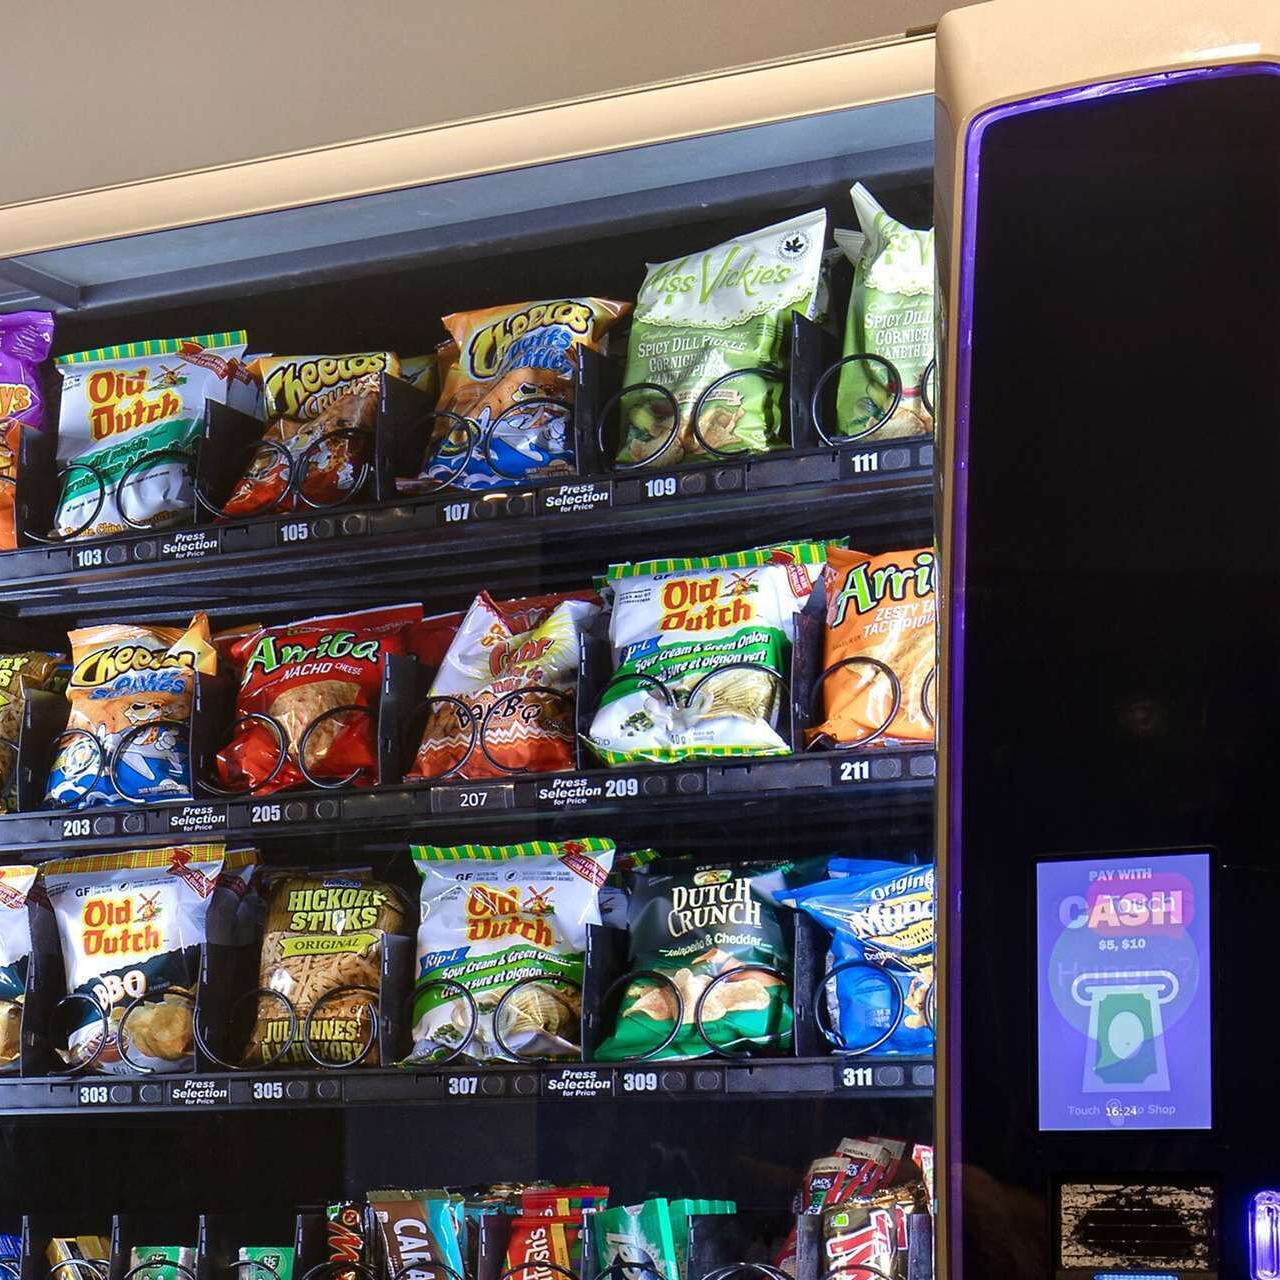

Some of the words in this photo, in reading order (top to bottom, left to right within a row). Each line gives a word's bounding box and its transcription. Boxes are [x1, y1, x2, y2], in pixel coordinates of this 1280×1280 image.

[471, 301, 592, 380] Cheetos
[638, 341, 670, 358] SPICY
[673, 337, 700, 354] DILL
[88, 368, 150, 404] Old
[265, 352, 388, 417] Cheetos
[90, 391, 182, 443] Dutch
[852, 453, 878, 472] 111
[559, 483, 594, 495] Press
[645, 478, 676, 497] 109
[546, 492, 608, 507] Selection
[573, 503, 594, 512] Price
[443, 504, 470, 522] 107
[175, 532, 205, 542] Press
[280, 523, 308, 541] 105
[162, 539, 218, 555] Selection
[76, 549, 102, 566] 103
[663, 577, 721, 610] Old
[659, 598, 753, 632] Dutch
[283, 662, 333, 682] NACHO
[335, 662, 363, 676] CHEESE
[840, 762, 869, 781] 211
[553, 777, 588, 789] Press
[605, 779, 639, 798] 209
[460, 793, 487, 808] 207
[539, 786, 602, 800] Selection
[170, 813, 226, 827] Selection
[183, 806, 213, 817] Press
[252, 805, 281, 822] 205
[63, 820, 91, 837] 203
[1089, 870, 1115, 882] PAY
[1118, 868, 1152, 880] WITH
[75, 886, 91, 898] GF
[288, 888, 387, 912] HICKORY
[466, 884, 521, 917] Old
[672, 878, 754, 912] DUTCH
[83, 898, 133, 929] Old
[1058, 890, 1183, 929] CASH
[290, 907, 378, 932] STICKS
[668, 900, 762, 938] CRUNCH
[82, 925, 163, 957] Dutch
[465, 918, 556, 948] Dutch
[714, 932, 762, 946] Cheddar
[294, 936, 359, 951] ORIGINAL
[1098, 938, 1118, 951] $5,
[1121, 938, 1146, 950] $10
[441, 966, 466, 980] Sour
[466, 959, 497, 973] Cream
[508, 950, 536, 963] Green
[561, 1069, 597, 1080] Press
[623, 1073, 657, 1091] 309
[843, 1068, 873, 1086] 311
[254, 1082, 283, 1100] 305
[449, 1078, 478, 1095] 307
[548, 1078, 611, 1091] Selection
[574, 1089, 596, 1097] Price
[80, 1086, 108, 1103] 303
[1105, 1105, 1137, 1117] 16:24
[1147, 1103, 1176, 1116] Shop
